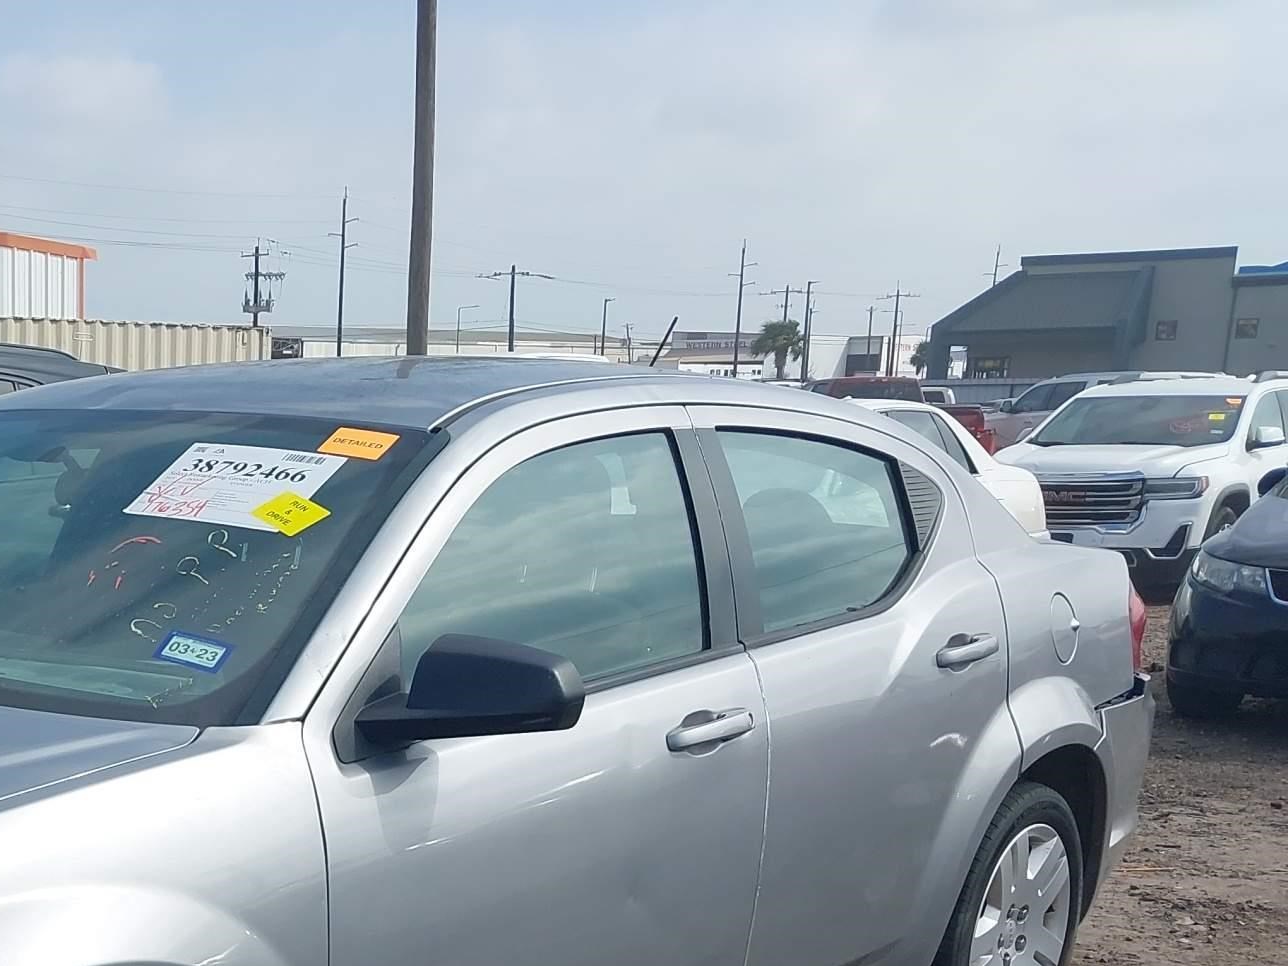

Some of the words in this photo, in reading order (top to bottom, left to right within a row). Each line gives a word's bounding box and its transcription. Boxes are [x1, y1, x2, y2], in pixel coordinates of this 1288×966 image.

[333, 437, 384, 449] DETAILED
[182, 458, 312, 483] 38792466
[289, 500, 309, 513] RUN
[265, 510, 292, 527] DRIVE
